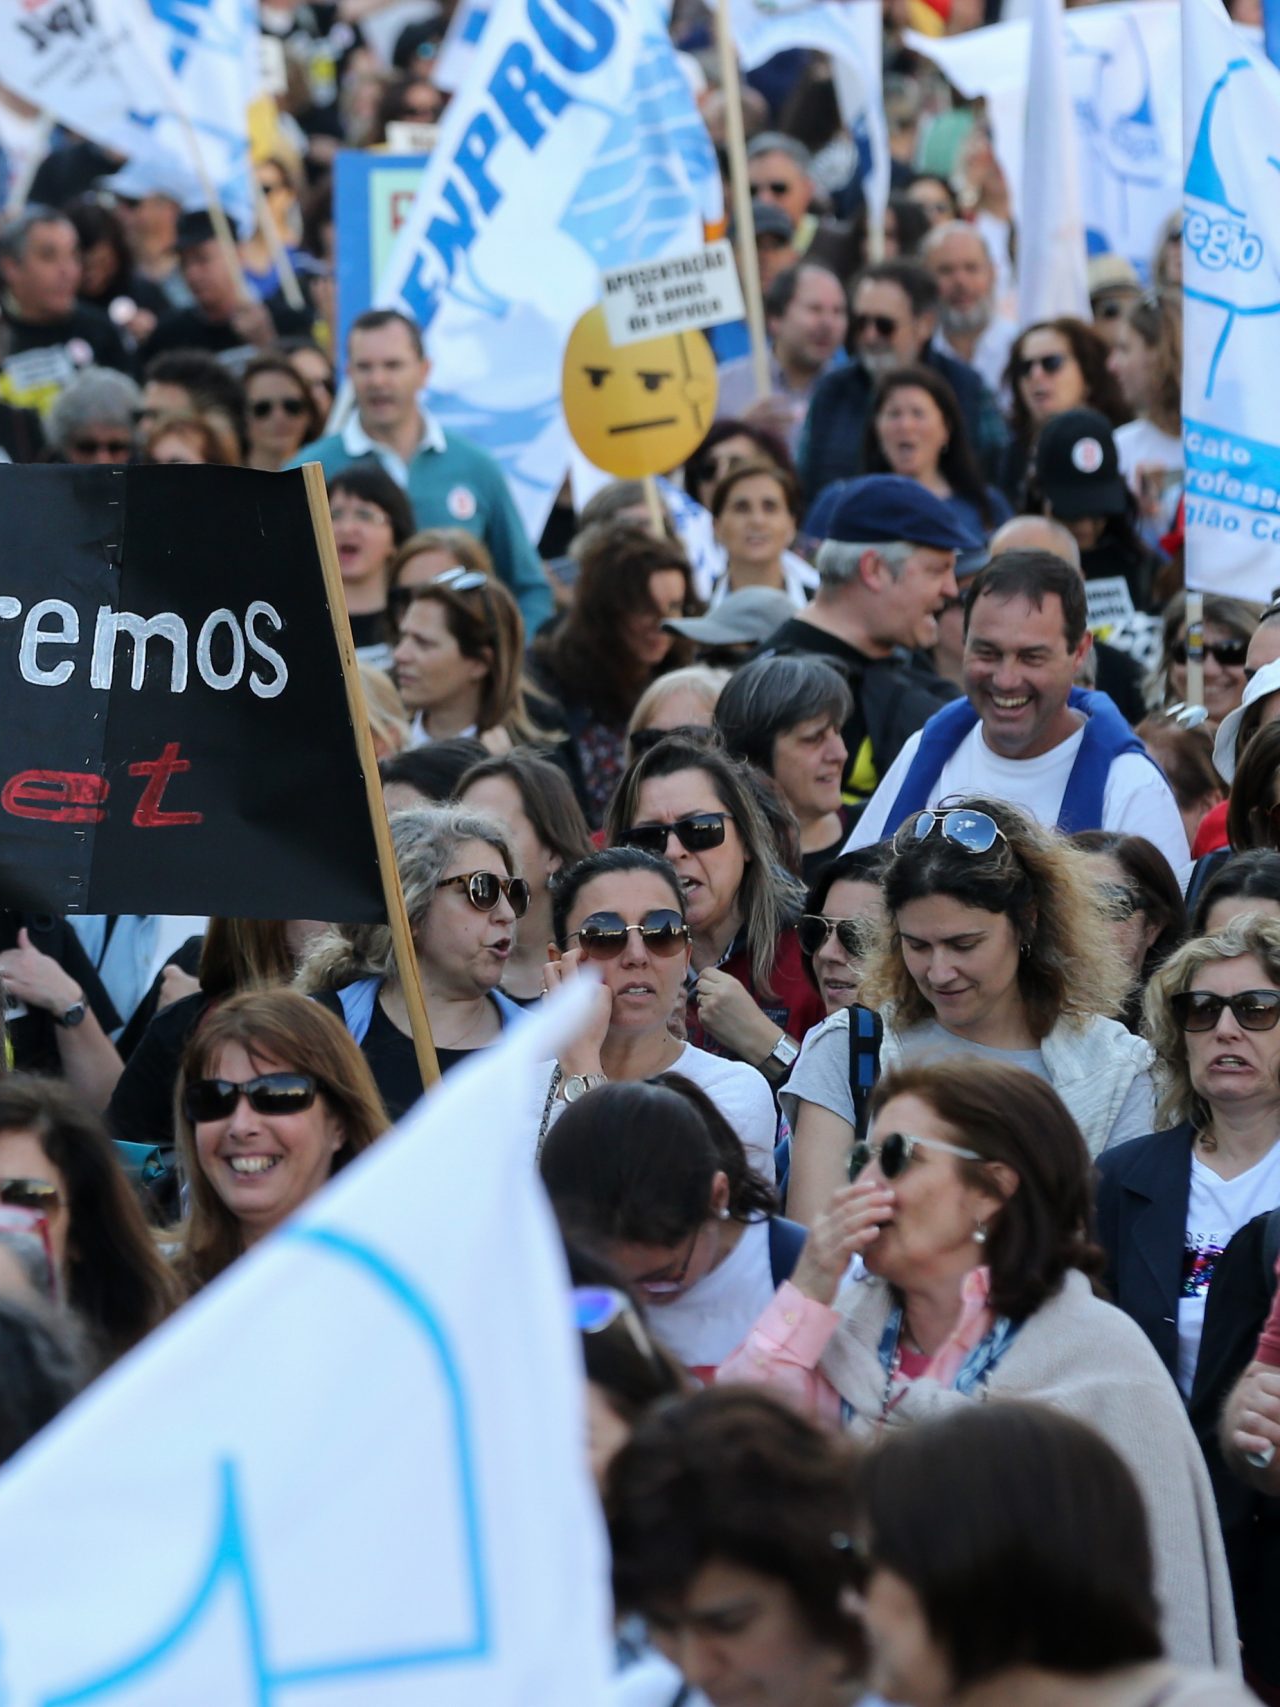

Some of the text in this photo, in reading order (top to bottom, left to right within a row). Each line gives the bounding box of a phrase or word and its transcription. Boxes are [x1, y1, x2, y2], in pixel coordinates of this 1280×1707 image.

[629, 315, 649, 331] de
[1184, 424, 1251, 466] cato
[1186, 466, 1280, 512] rofess
